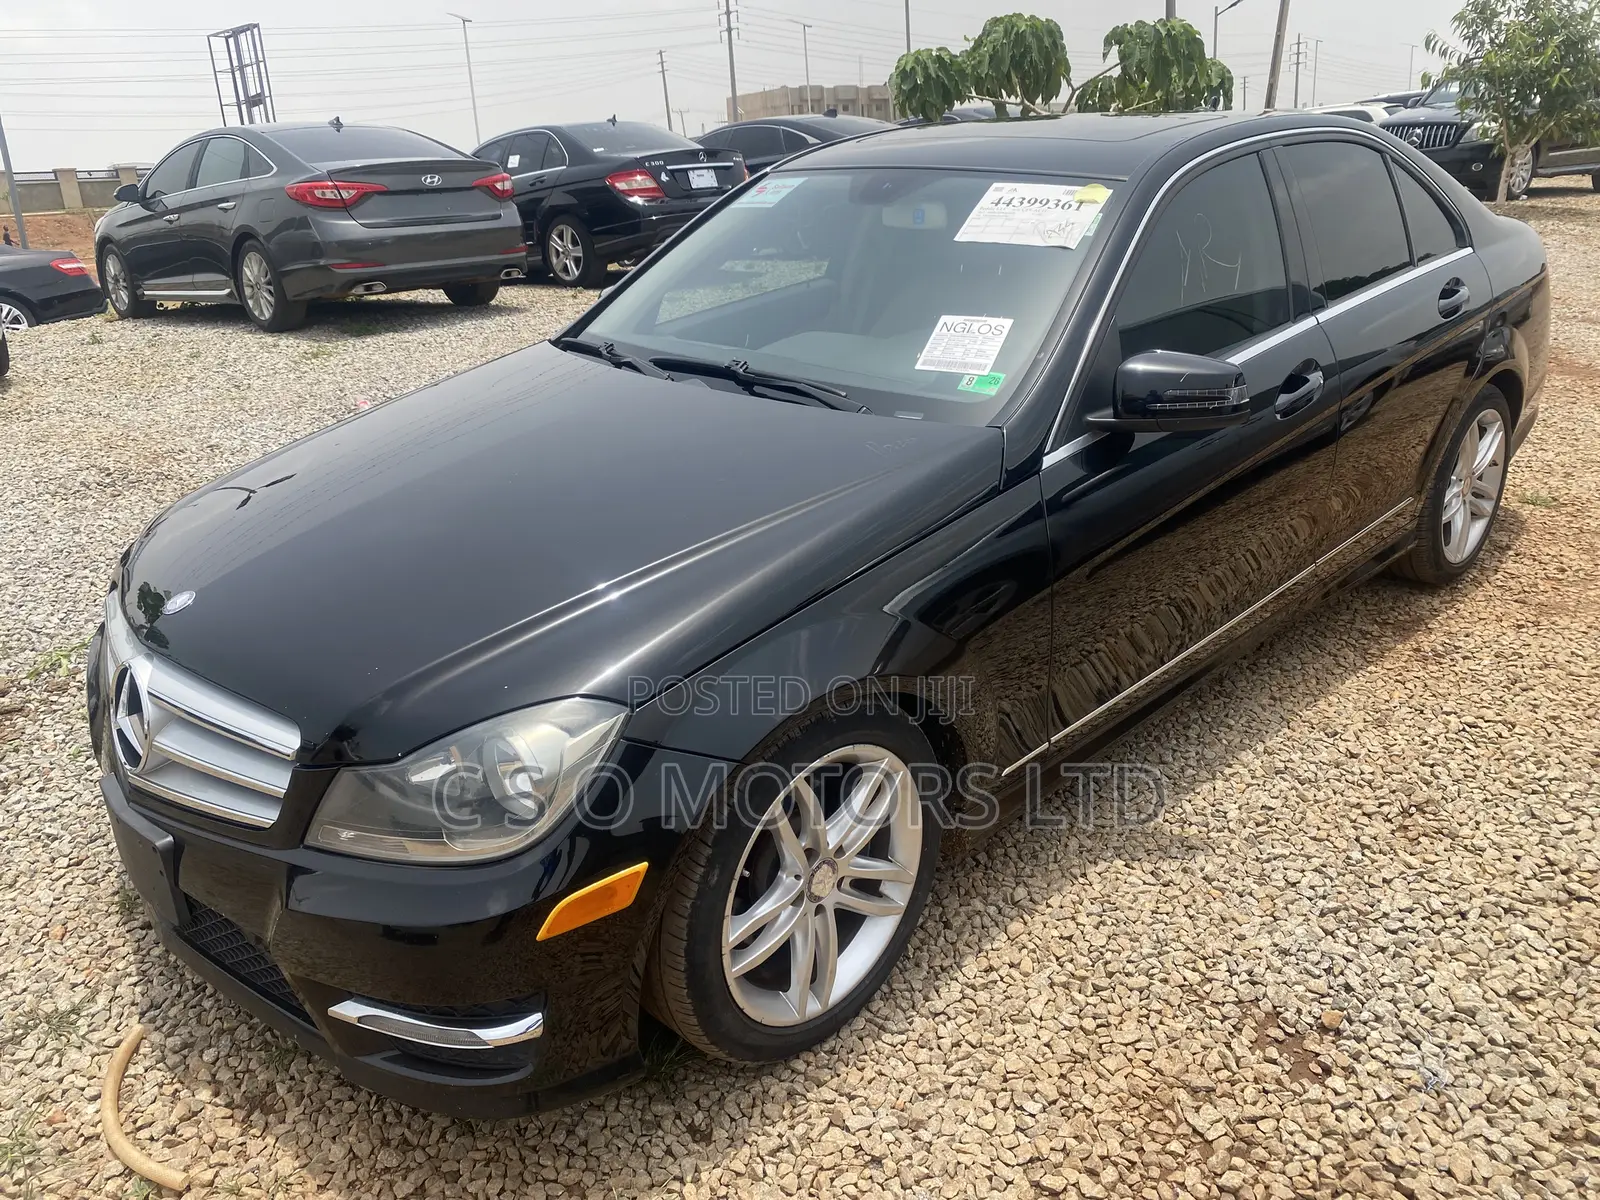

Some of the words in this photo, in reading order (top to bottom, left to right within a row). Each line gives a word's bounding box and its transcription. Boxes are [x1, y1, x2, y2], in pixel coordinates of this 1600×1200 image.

[990, 196, 1085, 212] 44399361
[939, 321, 1005, 336] NGLOS
[965, 376, 975, 386] 8
